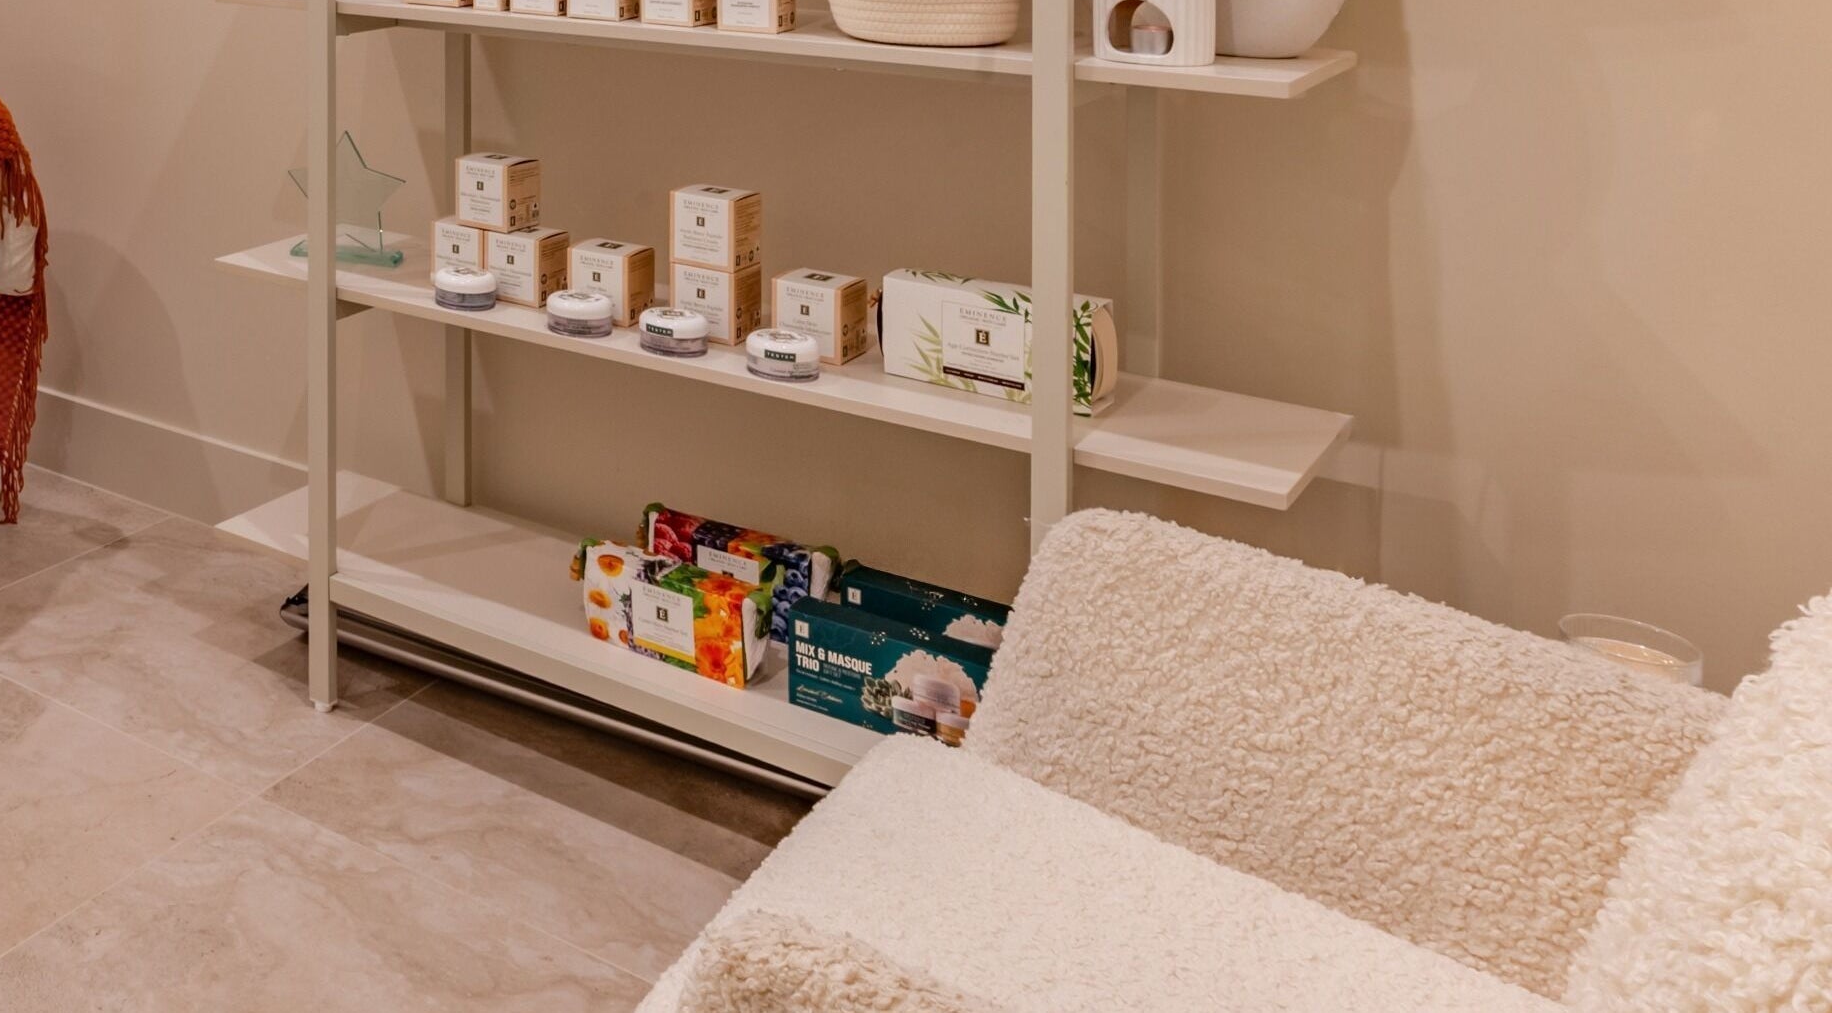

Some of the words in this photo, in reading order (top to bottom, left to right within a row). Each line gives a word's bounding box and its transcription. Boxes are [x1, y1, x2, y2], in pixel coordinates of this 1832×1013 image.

[795, 640, 815, 658] MIX
[818, 648, 826, 661] &
[828, 650, 873, 676] MASQUE
[795, 653, 820, 673] TRIO
